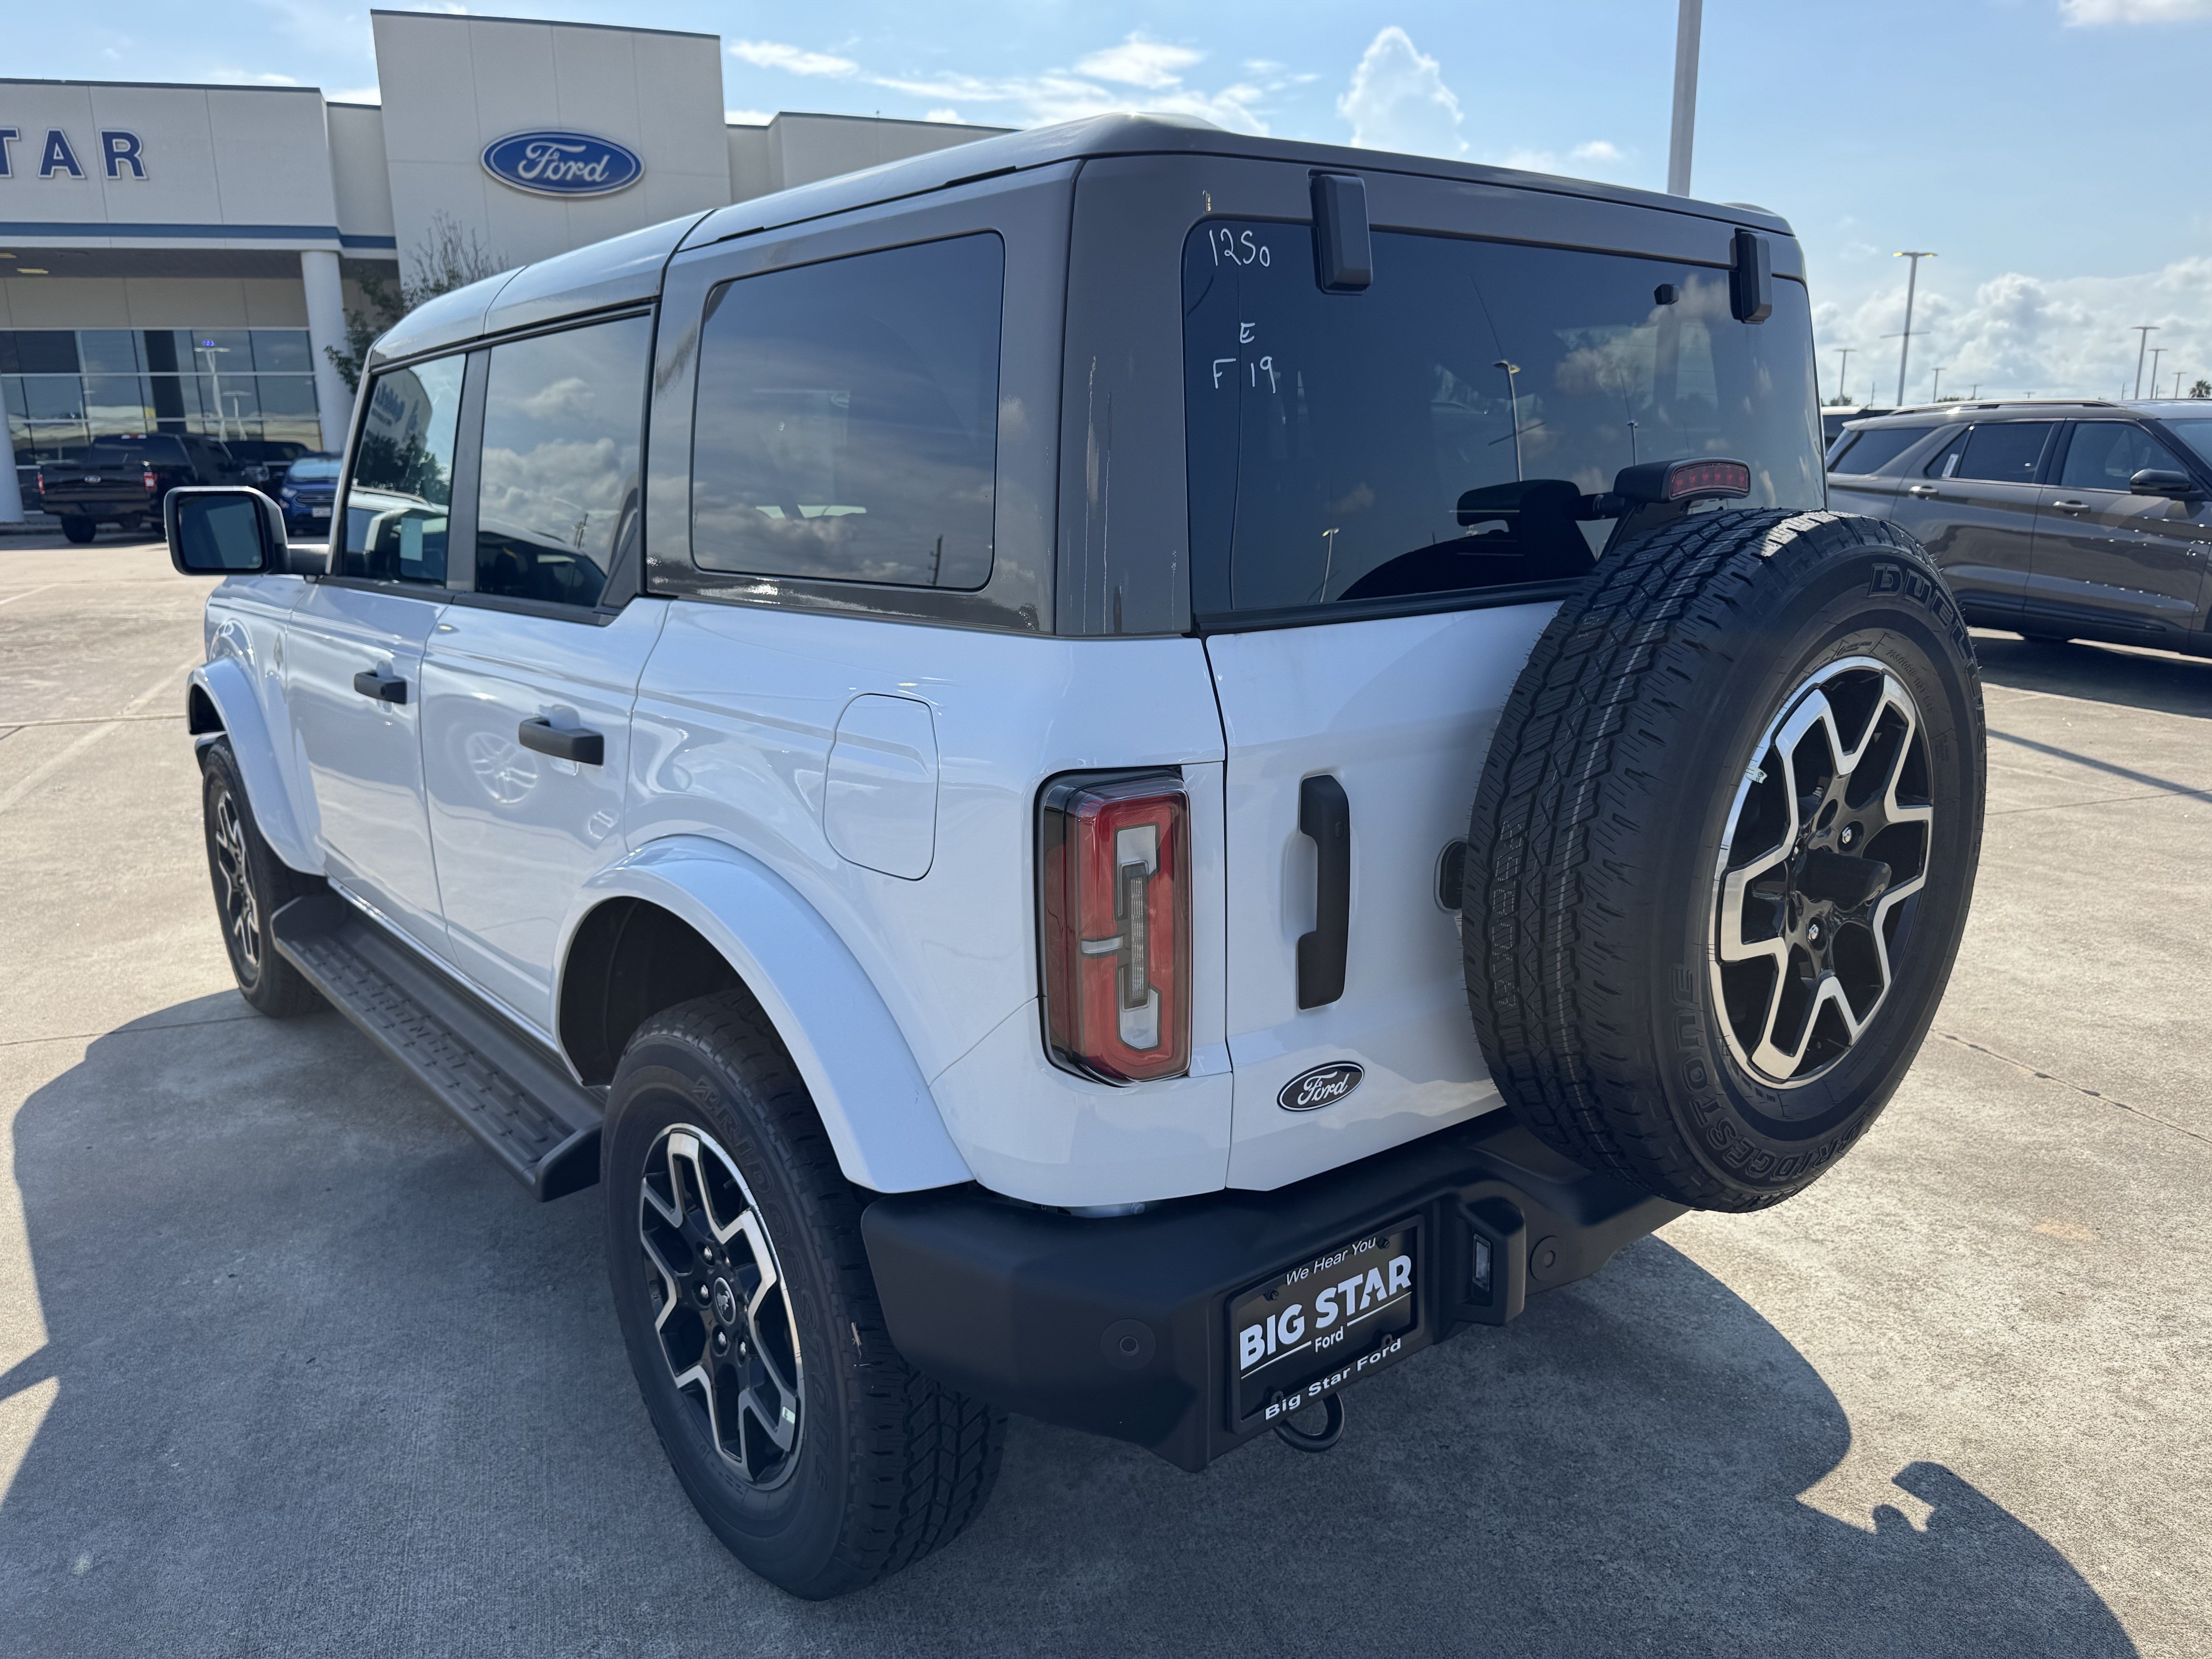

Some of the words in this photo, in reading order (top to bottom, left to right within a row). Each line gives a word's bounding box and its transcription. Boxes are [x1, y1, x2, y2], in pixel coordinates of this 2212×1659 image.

[518, 141, 610, 182] Ford
[1239, 322, 1255, 344] E
[1212, 358, 1237, 389] F
[1250, 356, 1276, 394] 19
[1297, 1071, 1350, 1105] Ford
[1286, 1267, 1309, 1286] We
[1313, 1249, 1348, 1274] Hear
[1352, 1237, 1377, 1256] You
[1239, 1304, 1305, 1370] BIG
[1315, 1255, 1412, 1328] STAR
[1315, 1326, 1344, 1353] Ford
[1265, 1394, 1301, 1421] Big
[1308, 1367, 1351, 1396] Star
[1357, 1338, 1401, 1371] Ford
